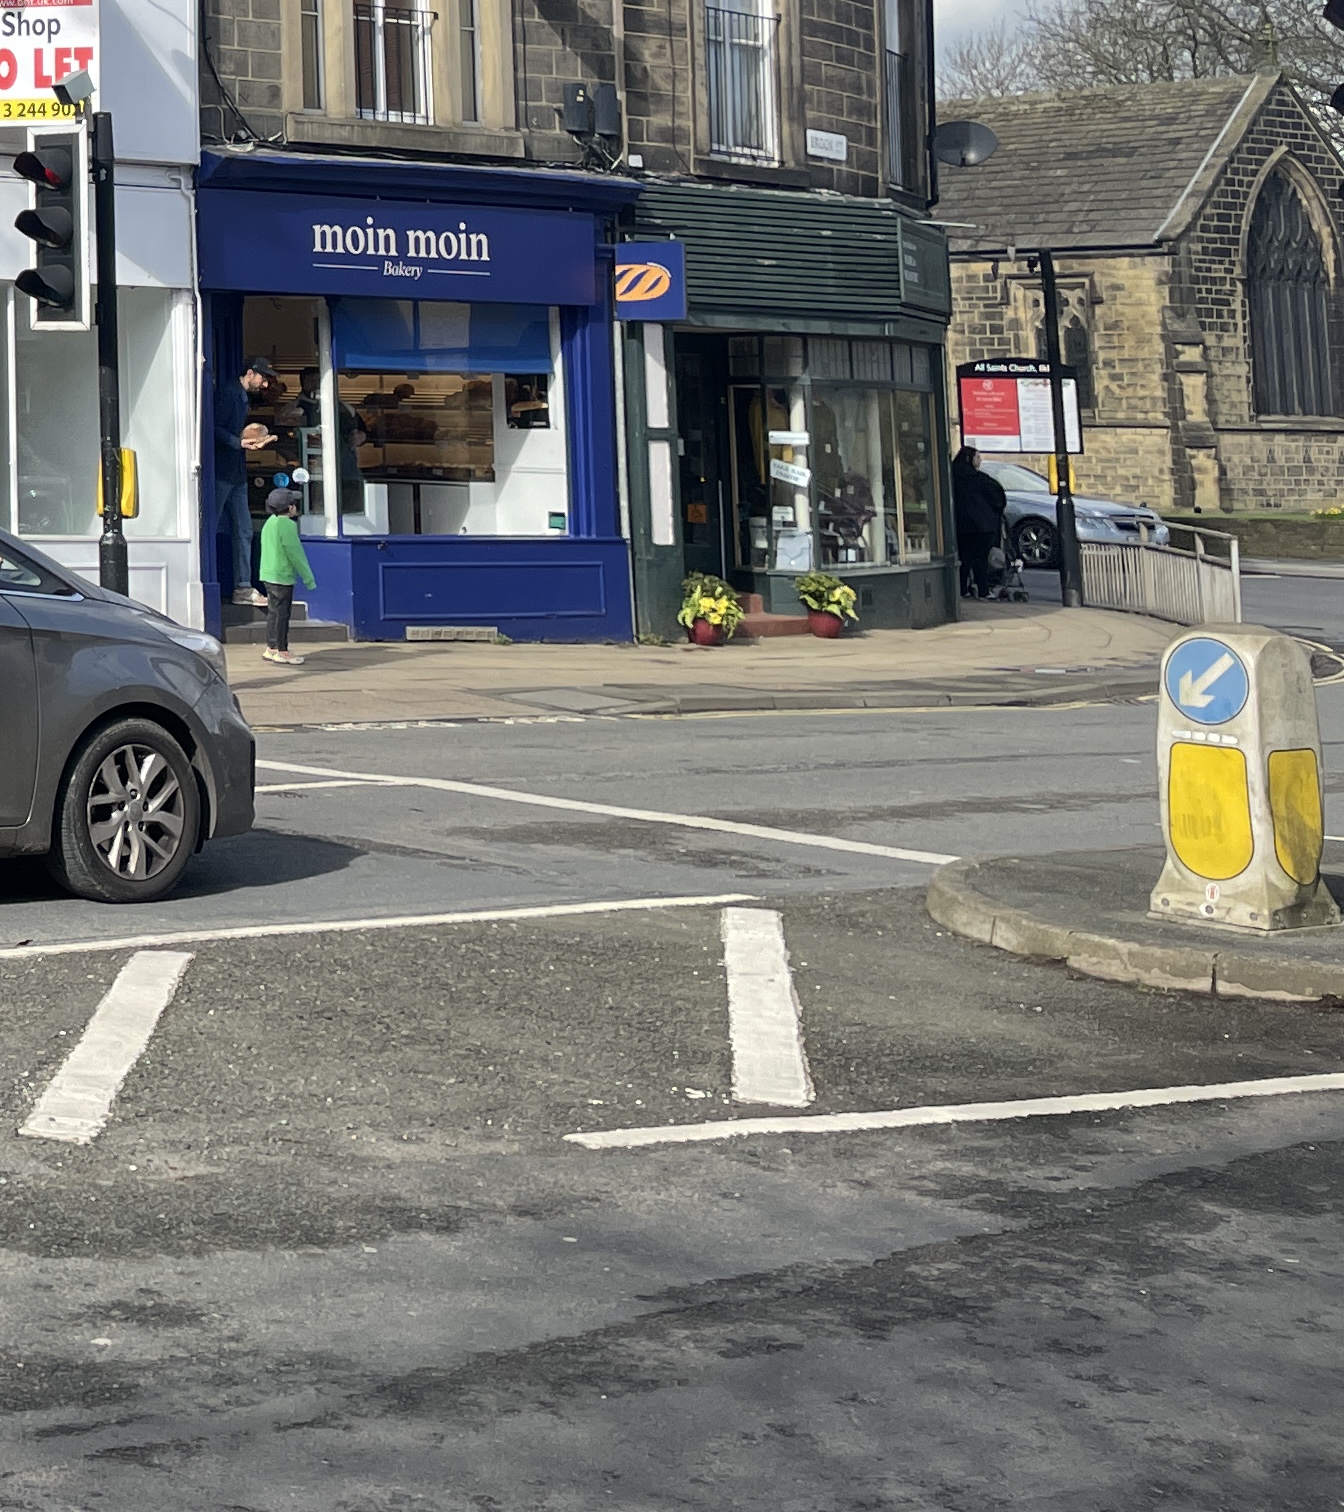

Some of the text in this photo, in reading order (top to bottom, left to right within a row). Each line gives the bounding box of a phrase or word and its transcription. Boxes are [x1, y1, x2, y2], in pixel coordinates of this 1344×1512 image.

[1, 11, 61, 43] Shop
[34, 46, 94, 89] LET
[17, 102, 47, 118] 244
[312, 216, 491, 261] moin moin
[383, 261, 423, 280] Bakery
